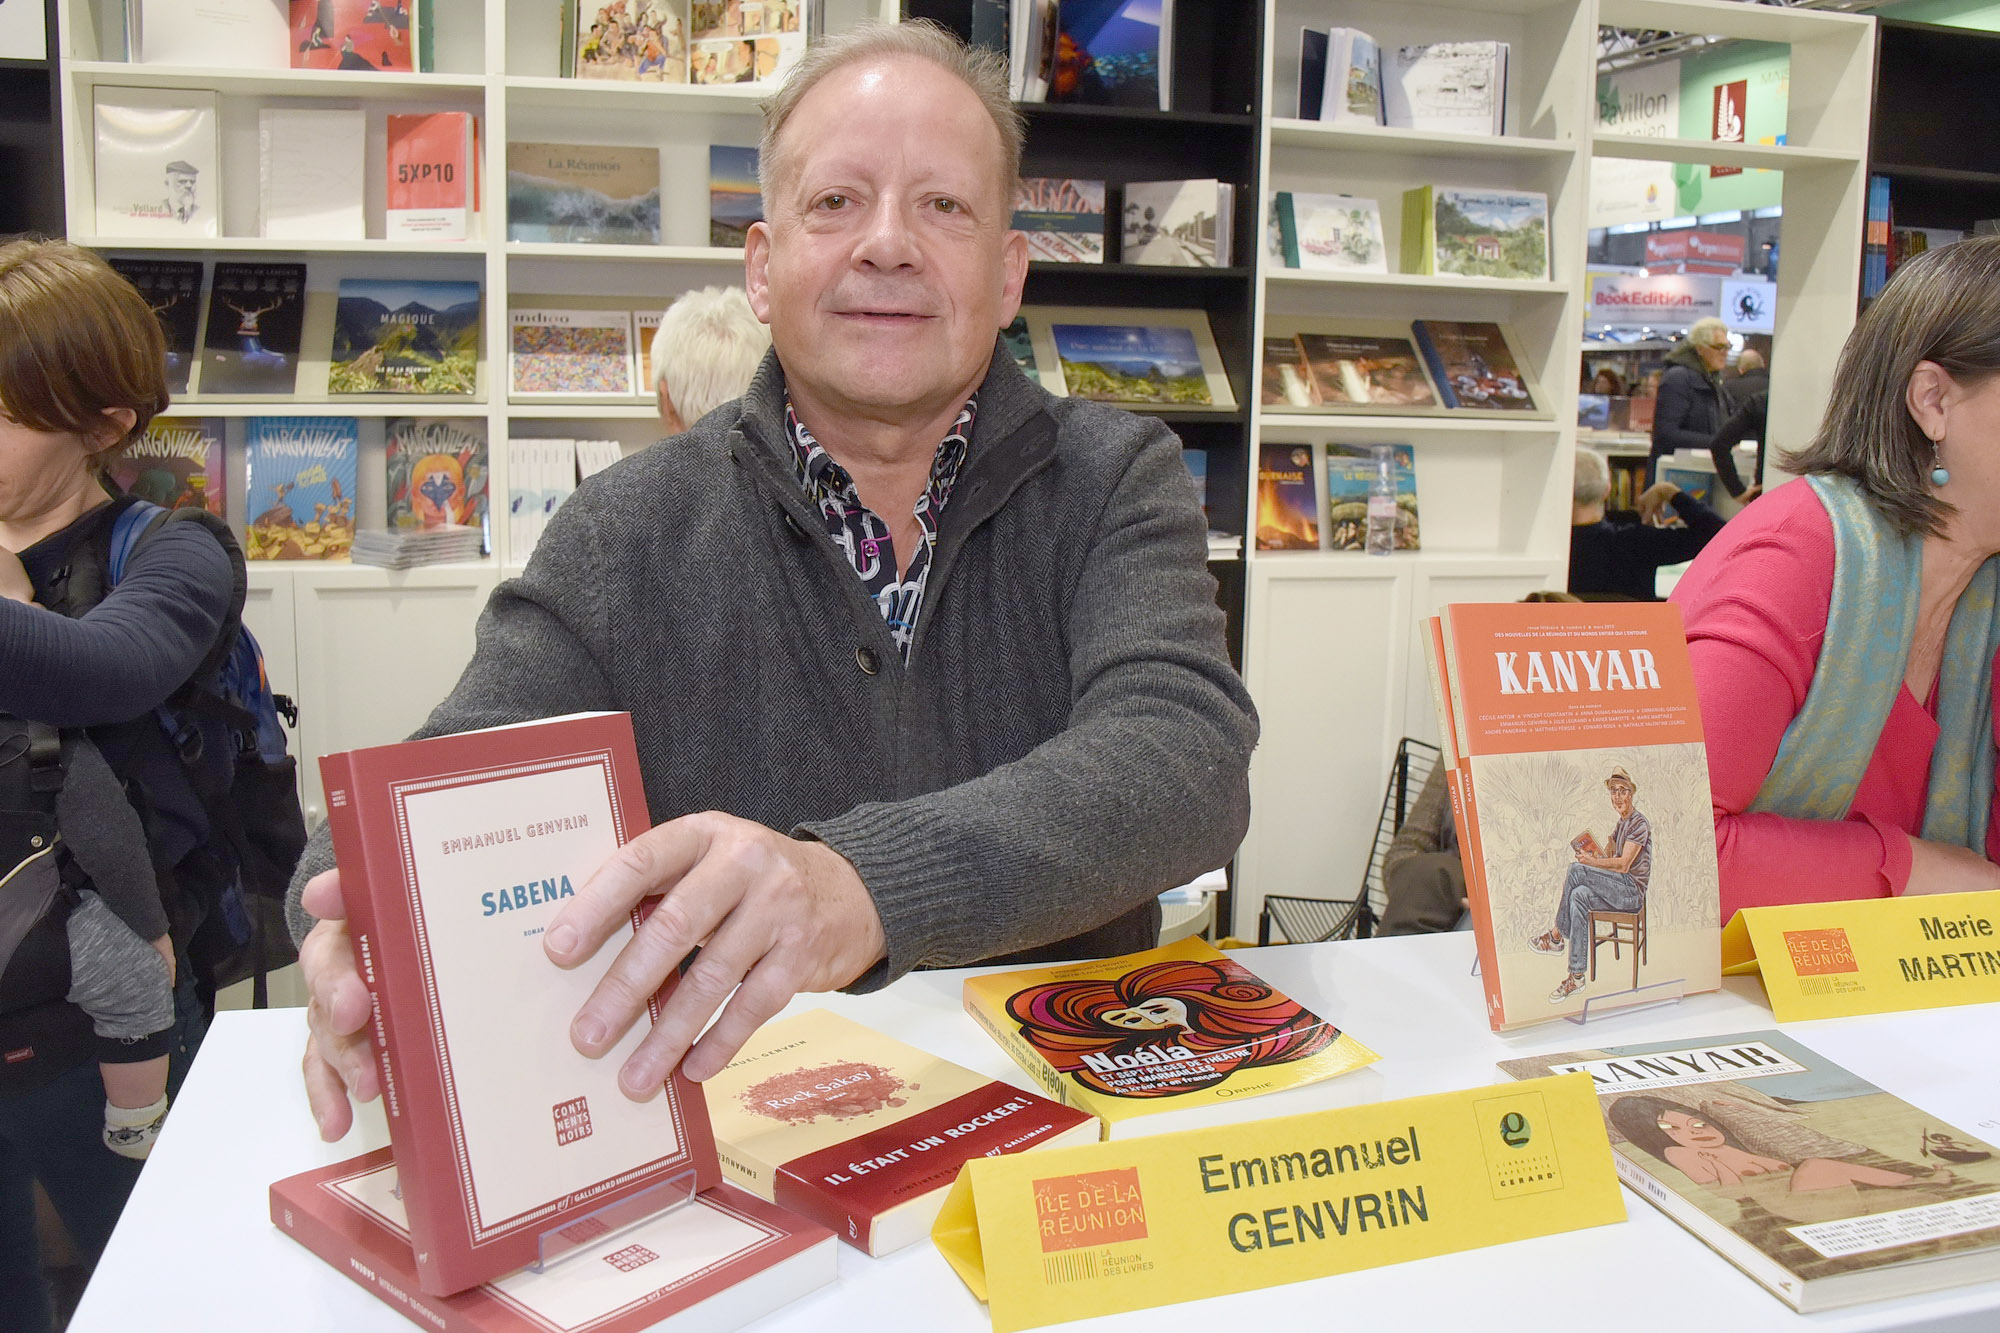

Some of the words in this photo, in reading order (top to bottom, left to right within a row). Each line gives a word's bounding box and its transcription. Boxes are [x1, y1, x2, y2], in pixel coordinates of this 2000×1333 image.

[1599, 92, 1668, 130] Pavillon
[548, 158, 563, 169] La
[566, 158, 621, 172] Réunion
[133, 203, 163, 213] Vollard
[380, 313, 434, 325] MAGIQUE
[1494, 649, 1661, 695] KANYAR
[1449, 785, 1460, 815] KANYAR
[1464, 772, 1473, 803] KANYAR
[441, 827, 521, 855] EMMANUEL
[526, 814, 589, 838] GENVRIN
[481, 875, 575, 917] SABENA
[523, 927, 545, 937] ROMAN
[1919, 914, 1994, 941] Marie
[1812, 939, 1830, 952] DE
[1834, 936, 1850, 951] LA
[359, 934, 376, 984] SABENA
[1793, 950, 1855, 968] RÉUNION
[370, 991, 387, 1047] GENVRIN
[724, 1055, 759, 1070] ANUEL
[761, 1040, 807, 1058] GENVRIN
[1080, 1045, 1198, 1073] Noéla
[1099, 1072, 1115, 1082] ET
[1116, 1067, 1148, 1080] SEPT
[1148, 1062, 1187, 1075] PIÈCES
[1188, 1058, 1202, 1068] DE
[1201, 1049, 1252, 1066] THÉÂTRE
[380, 1051, 400, 1118] EMMANUEL
[765, 1087, 817, 1110] Rock
[815, 1069, 872, 1093] Sakay
[1041, 1061, 1067, 1106] Noéla
[1107, 1076, 1141, 1088] POUR
[1140, 1064, 1216, 1084] MARMAILLES
[1130, 1082, 1156, 1093] kréol
[1157, 1081, 1169, 1090] et
[1170, 1079, 1182, 1087] en
[1181, 1072, 1223, 1085] français
[554, 1098, 587, 1120] CONTI
[556, 1111, 590, 1131] NENTS
[558, 1123, 593, 1145] NOIRS
[1004, 1123, 1053, 1149] GALLIMARD
[824, 1170, 853, 1186] IL
[848, 1147, 912, 1176] ÉTAIT
[909, 1134, 946, 1152] UN
[1198, 1125, 1422, 1194] Emmanuel
[574, 1179, 617, 1203] GALLIMARD
[1037, 1187, 1070, 1215] ÎLE
[1078, 1188, 1108, 1210] DE
[1114, 1182, 1141, 1203] LA
[1042, 1206, 1145, 1237] RÉUNION
[1227, 1184, 1430, 1254] GENVRIN
[1100, 1249, 1112, 1258] LA
[1102, 1253, 1143, 1267] RÉUNION
[350, 1257, 376, 1282] SABENA
[1103, 1267, 1122, 1277] DES
[1123, 1261, 1154, 1275] LIVRES
